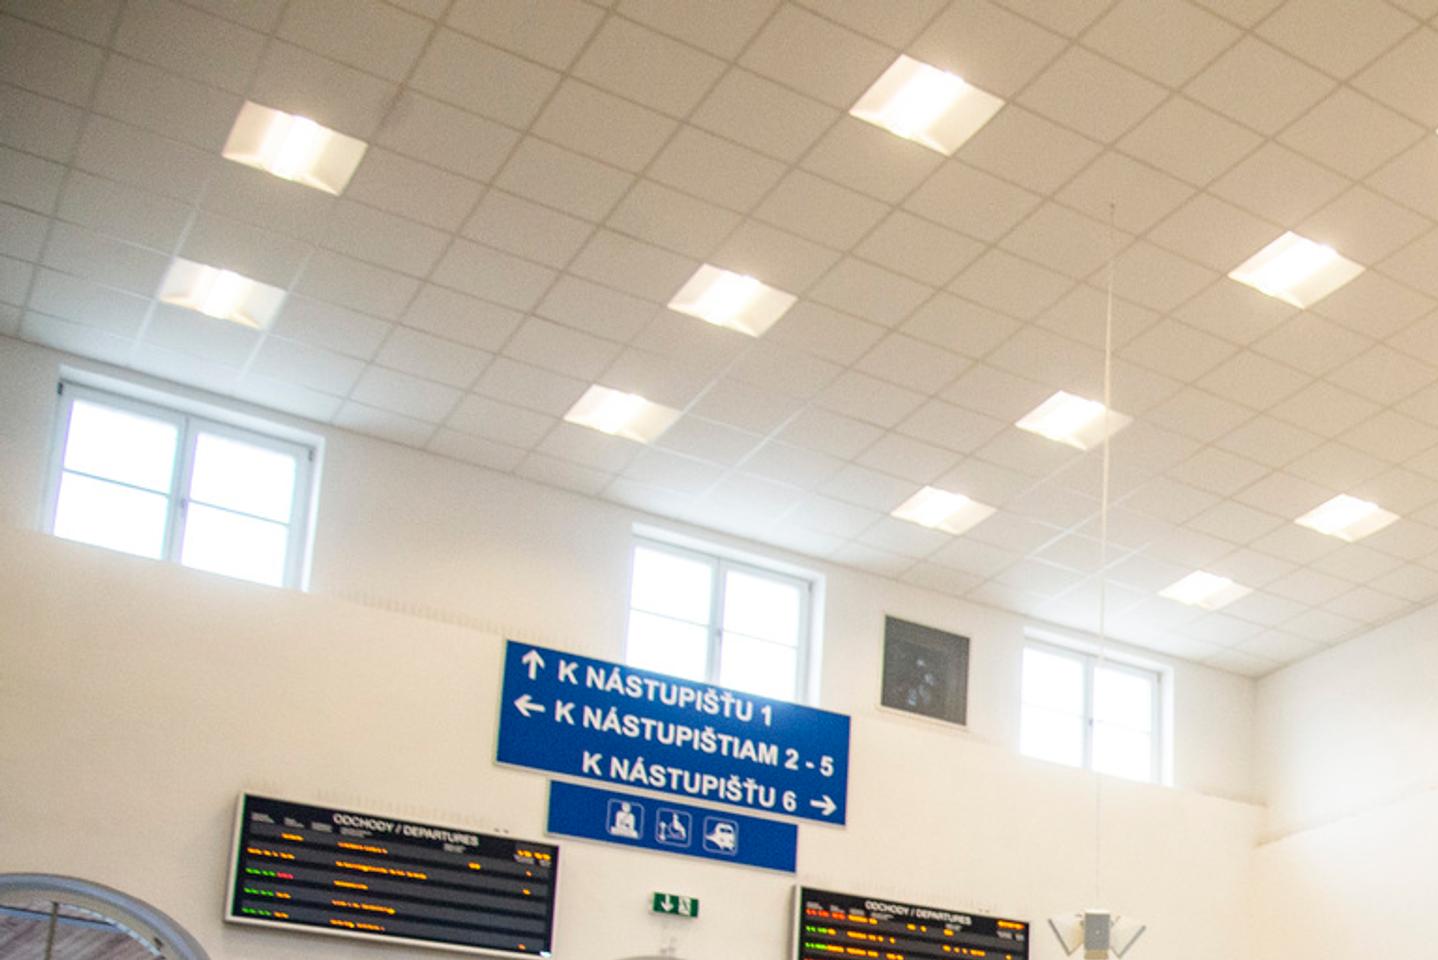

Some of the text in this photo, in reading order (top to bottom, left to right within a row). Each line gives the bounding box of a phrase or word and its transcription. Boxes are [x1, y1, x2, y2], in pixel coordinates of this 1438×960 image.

[558, 659, 773, 727] K NÁSTUPIŠŤU 1
[554, 699, 575, 726] K
[582, 706, 778, 766] NÁSTUPIŠTIAM
[784, 748, 799, 771] 2
[819, 756, 834, 777] 5
[582, 751, 797, 812] K NÁSTUPIŠŤU 6
[332, 813, 394, 833] ODCHODY
[403, 825, 479, 847] DEPARTURES
[916, 908, 972, 926] DEPARTURES
